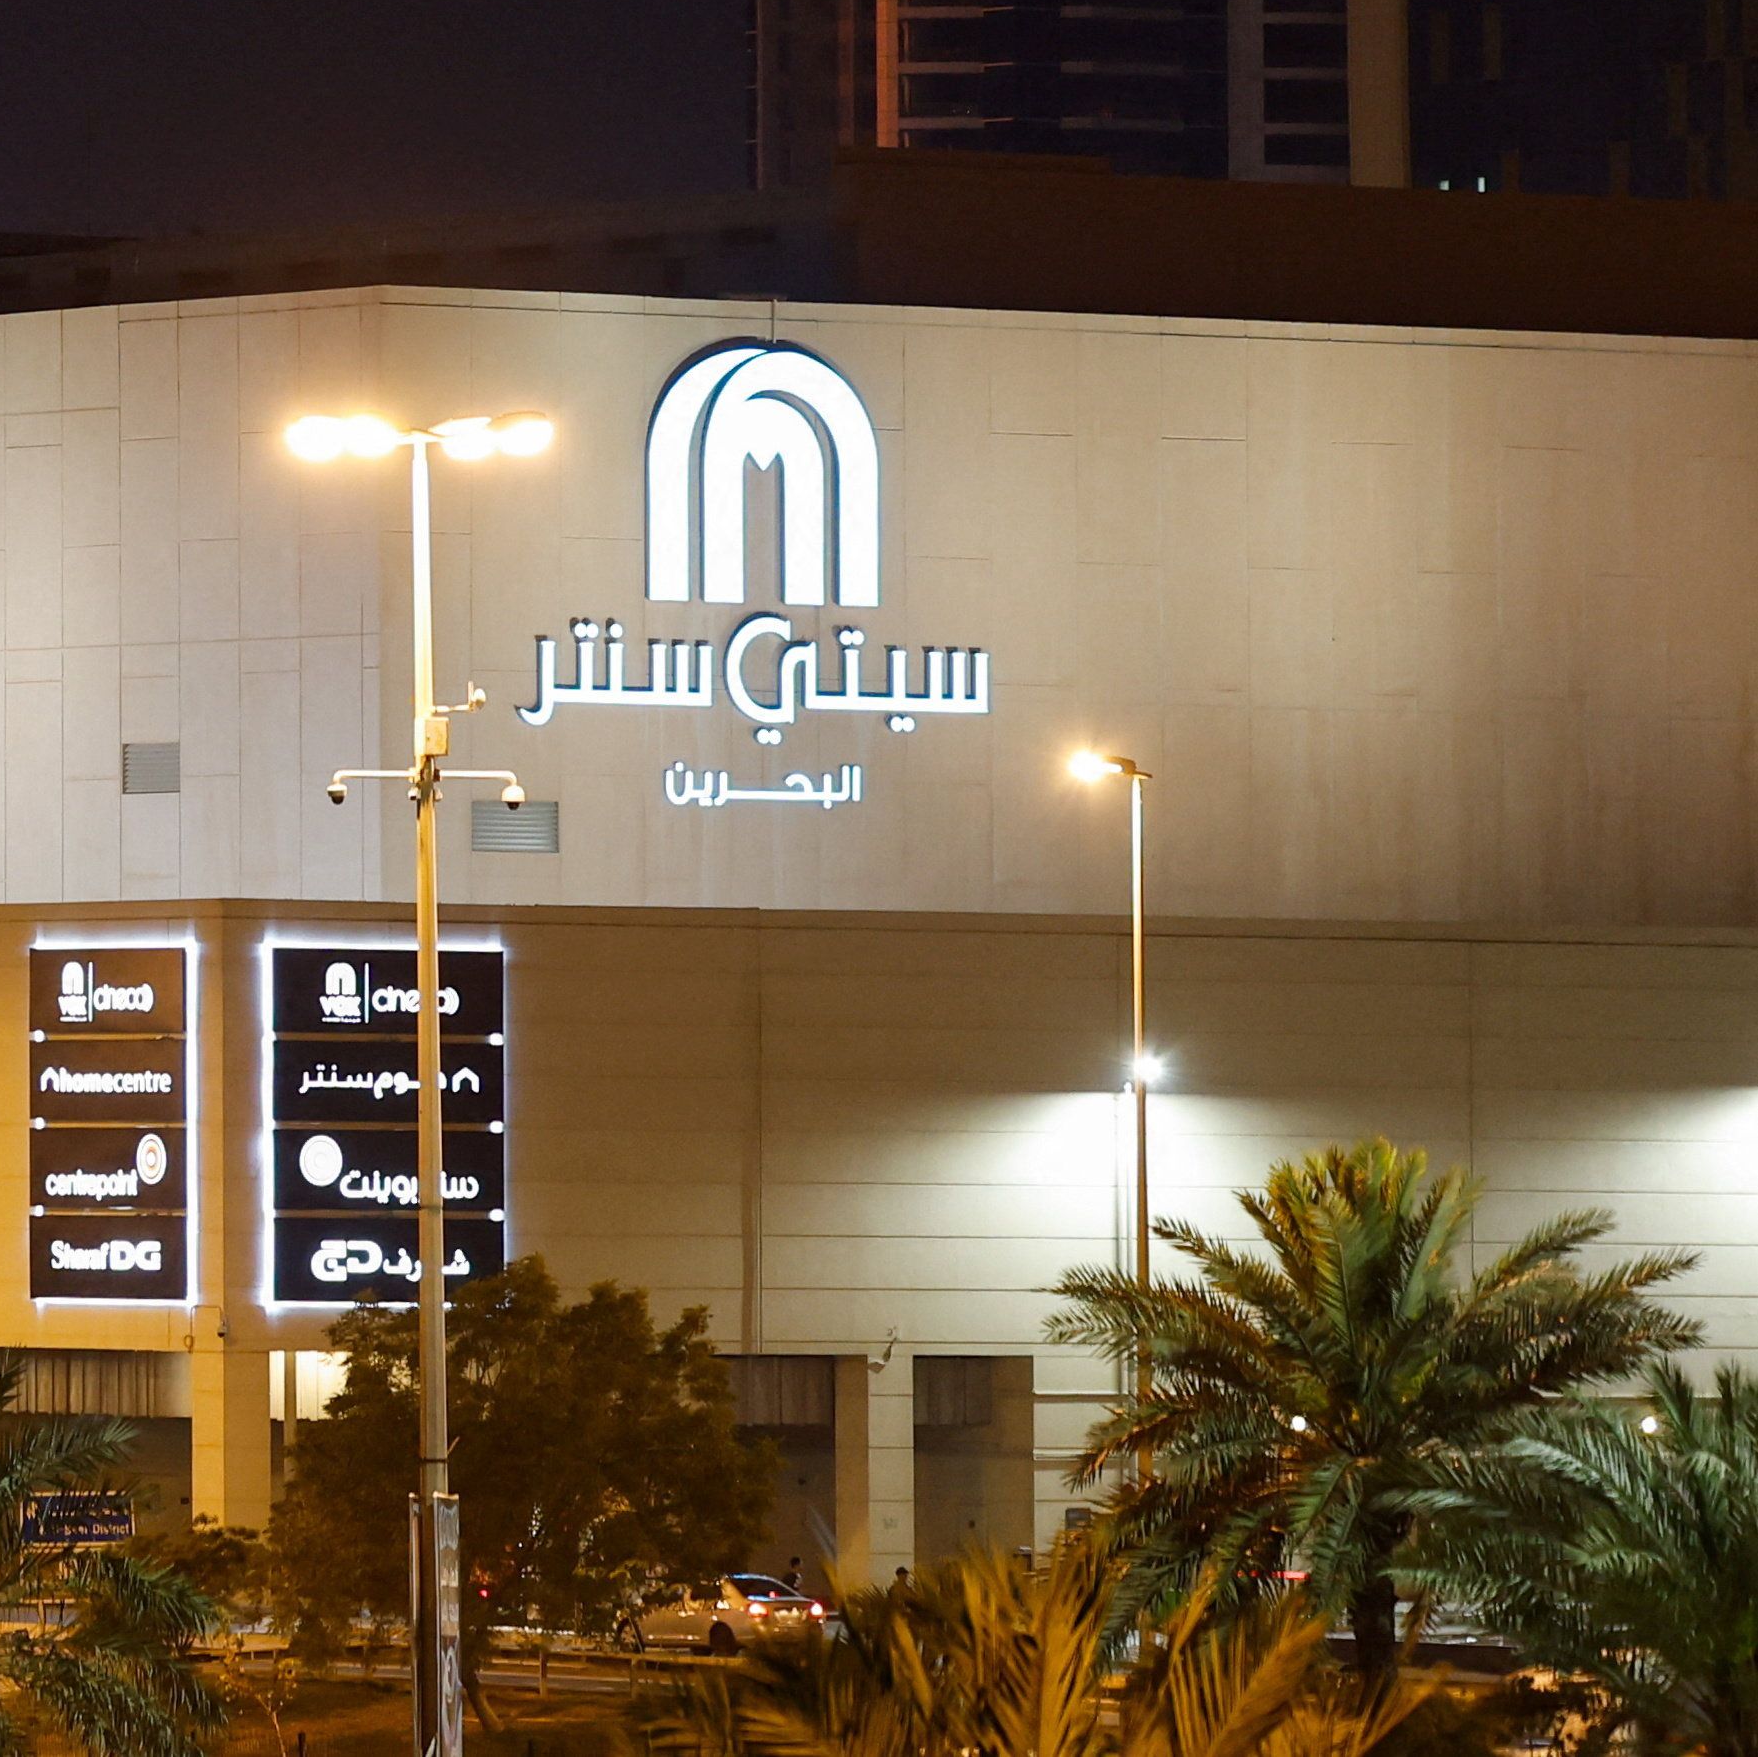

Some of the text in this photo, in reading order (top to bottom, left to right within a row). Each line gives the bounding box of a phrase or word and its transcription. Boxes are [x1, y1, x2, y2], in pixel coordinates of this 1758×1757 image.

[516, 614, 991, 746] سيتي سنتر
[664, 761, 862, 810] البحرين
[371, 985, 451, 1014] cineo
[58, 1067, 172, 1093] homecentre
[45, 1168, 138, 1202] centrepoint
[51, 1240, 162, 1271] Sharaf DG
